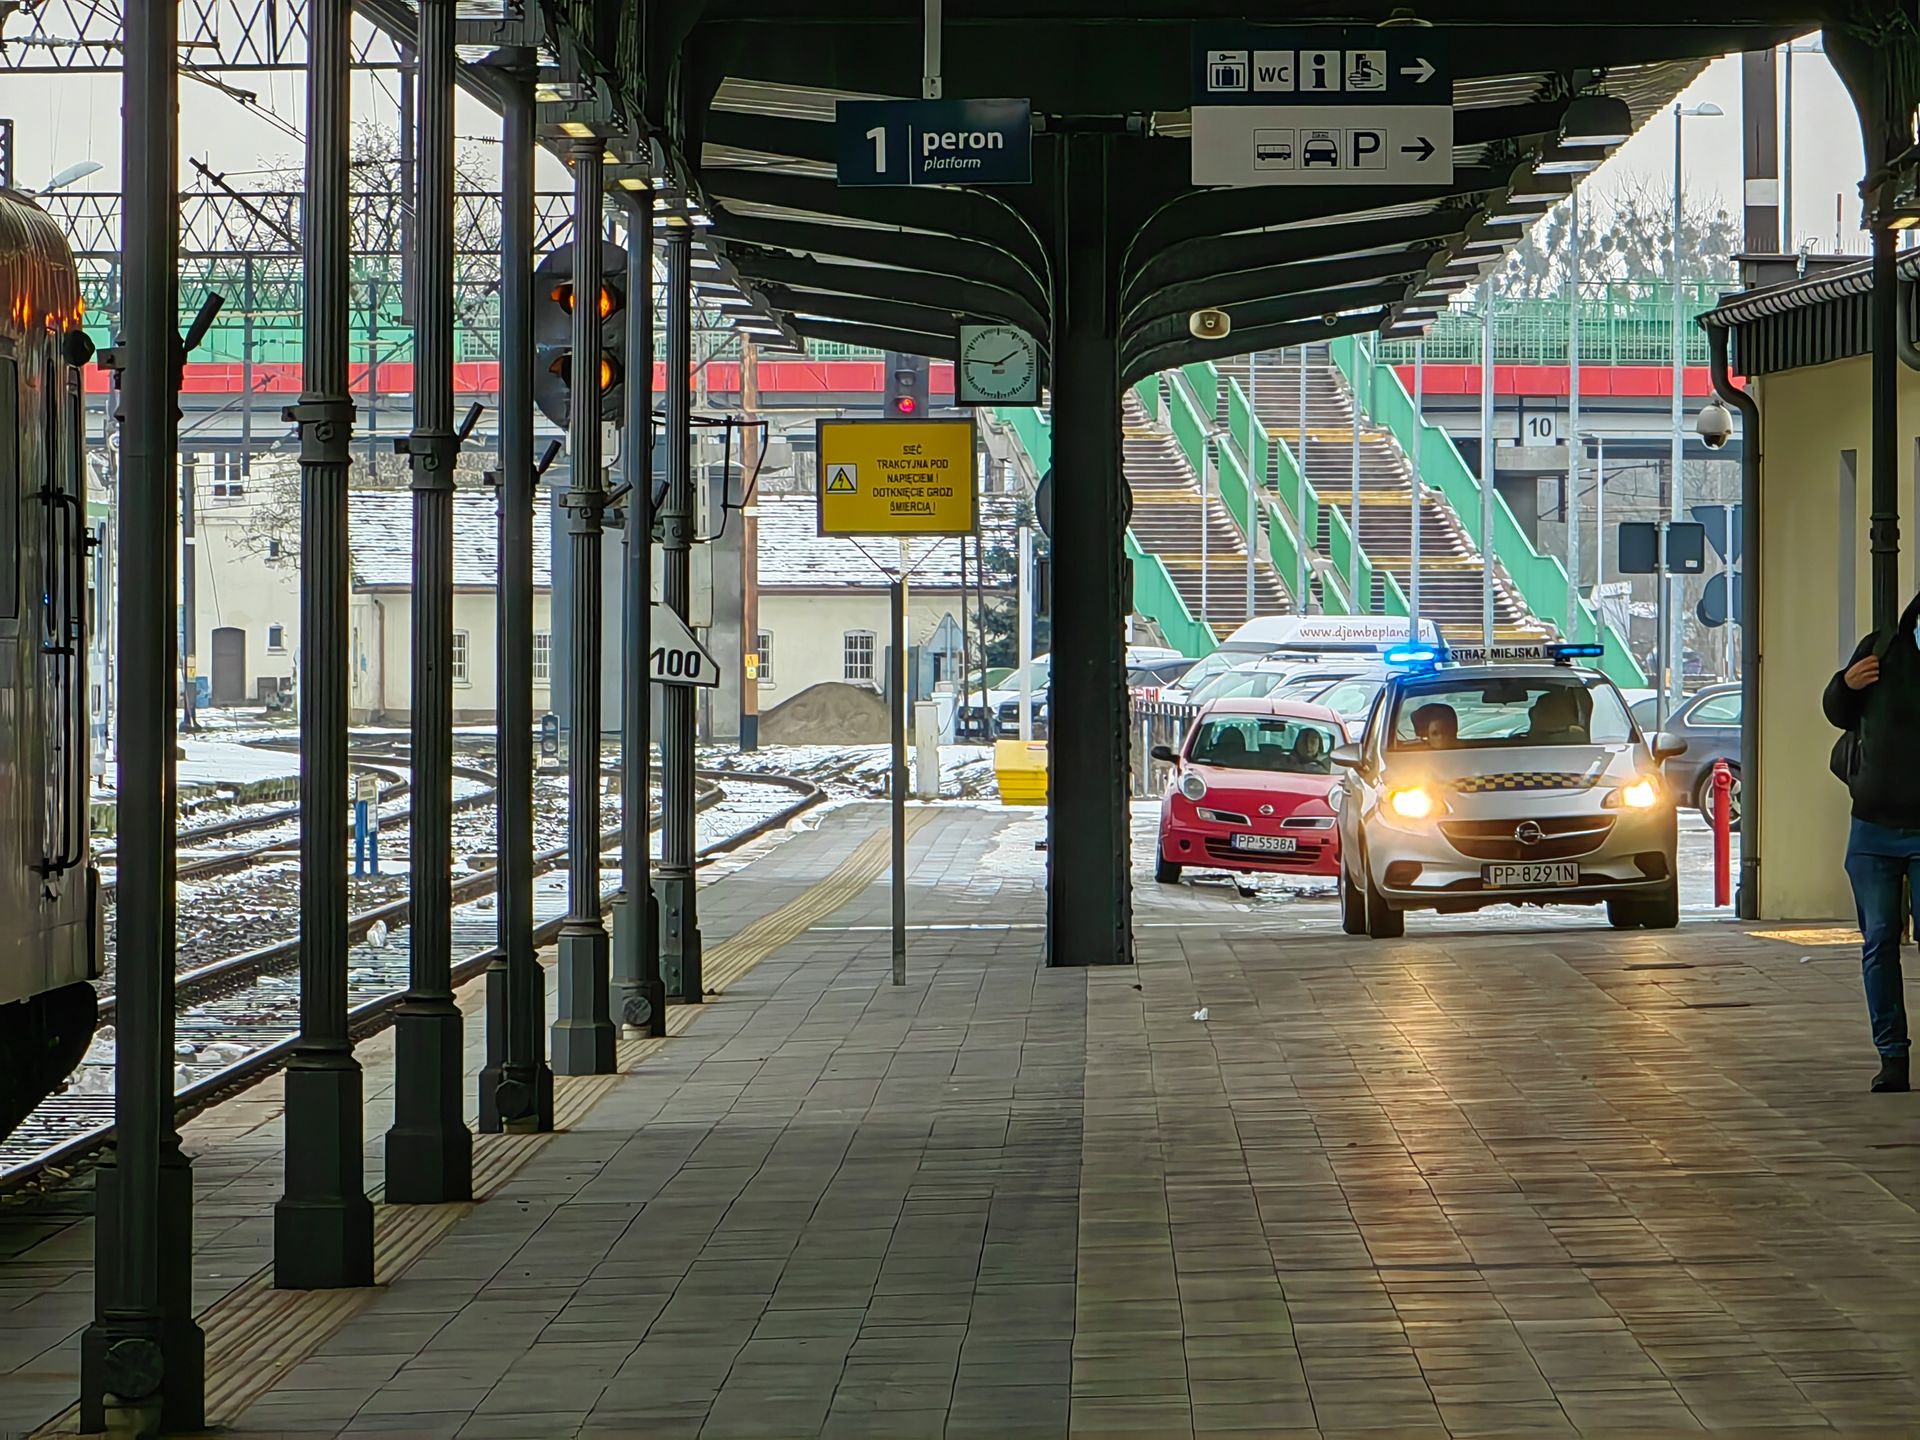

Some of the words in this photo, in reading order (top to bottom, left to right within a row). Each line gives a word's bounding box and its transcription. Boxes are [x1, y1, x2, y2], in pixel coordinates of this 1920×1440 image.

[1258, 66, 1289, 83] WC
[866, 126, 887, 173] 1
[922, 131, 1004, 157] peron
[1353, 131, 1381, 167] P
[923, 156, 982, 172] platform
[1528, 417, 1552, 437] 10
[876, 459, 928, 469] TRAKCYJNA
[930, 459, 949, 469] POD
[890, 501, 932, 514] ŚMIERCIĄ
[1299, 625, 1430, 641] www.djembeplanepl
[1490, 646, 1541, 659] MIEJSKA
[649, 647, 702, 678] 100
